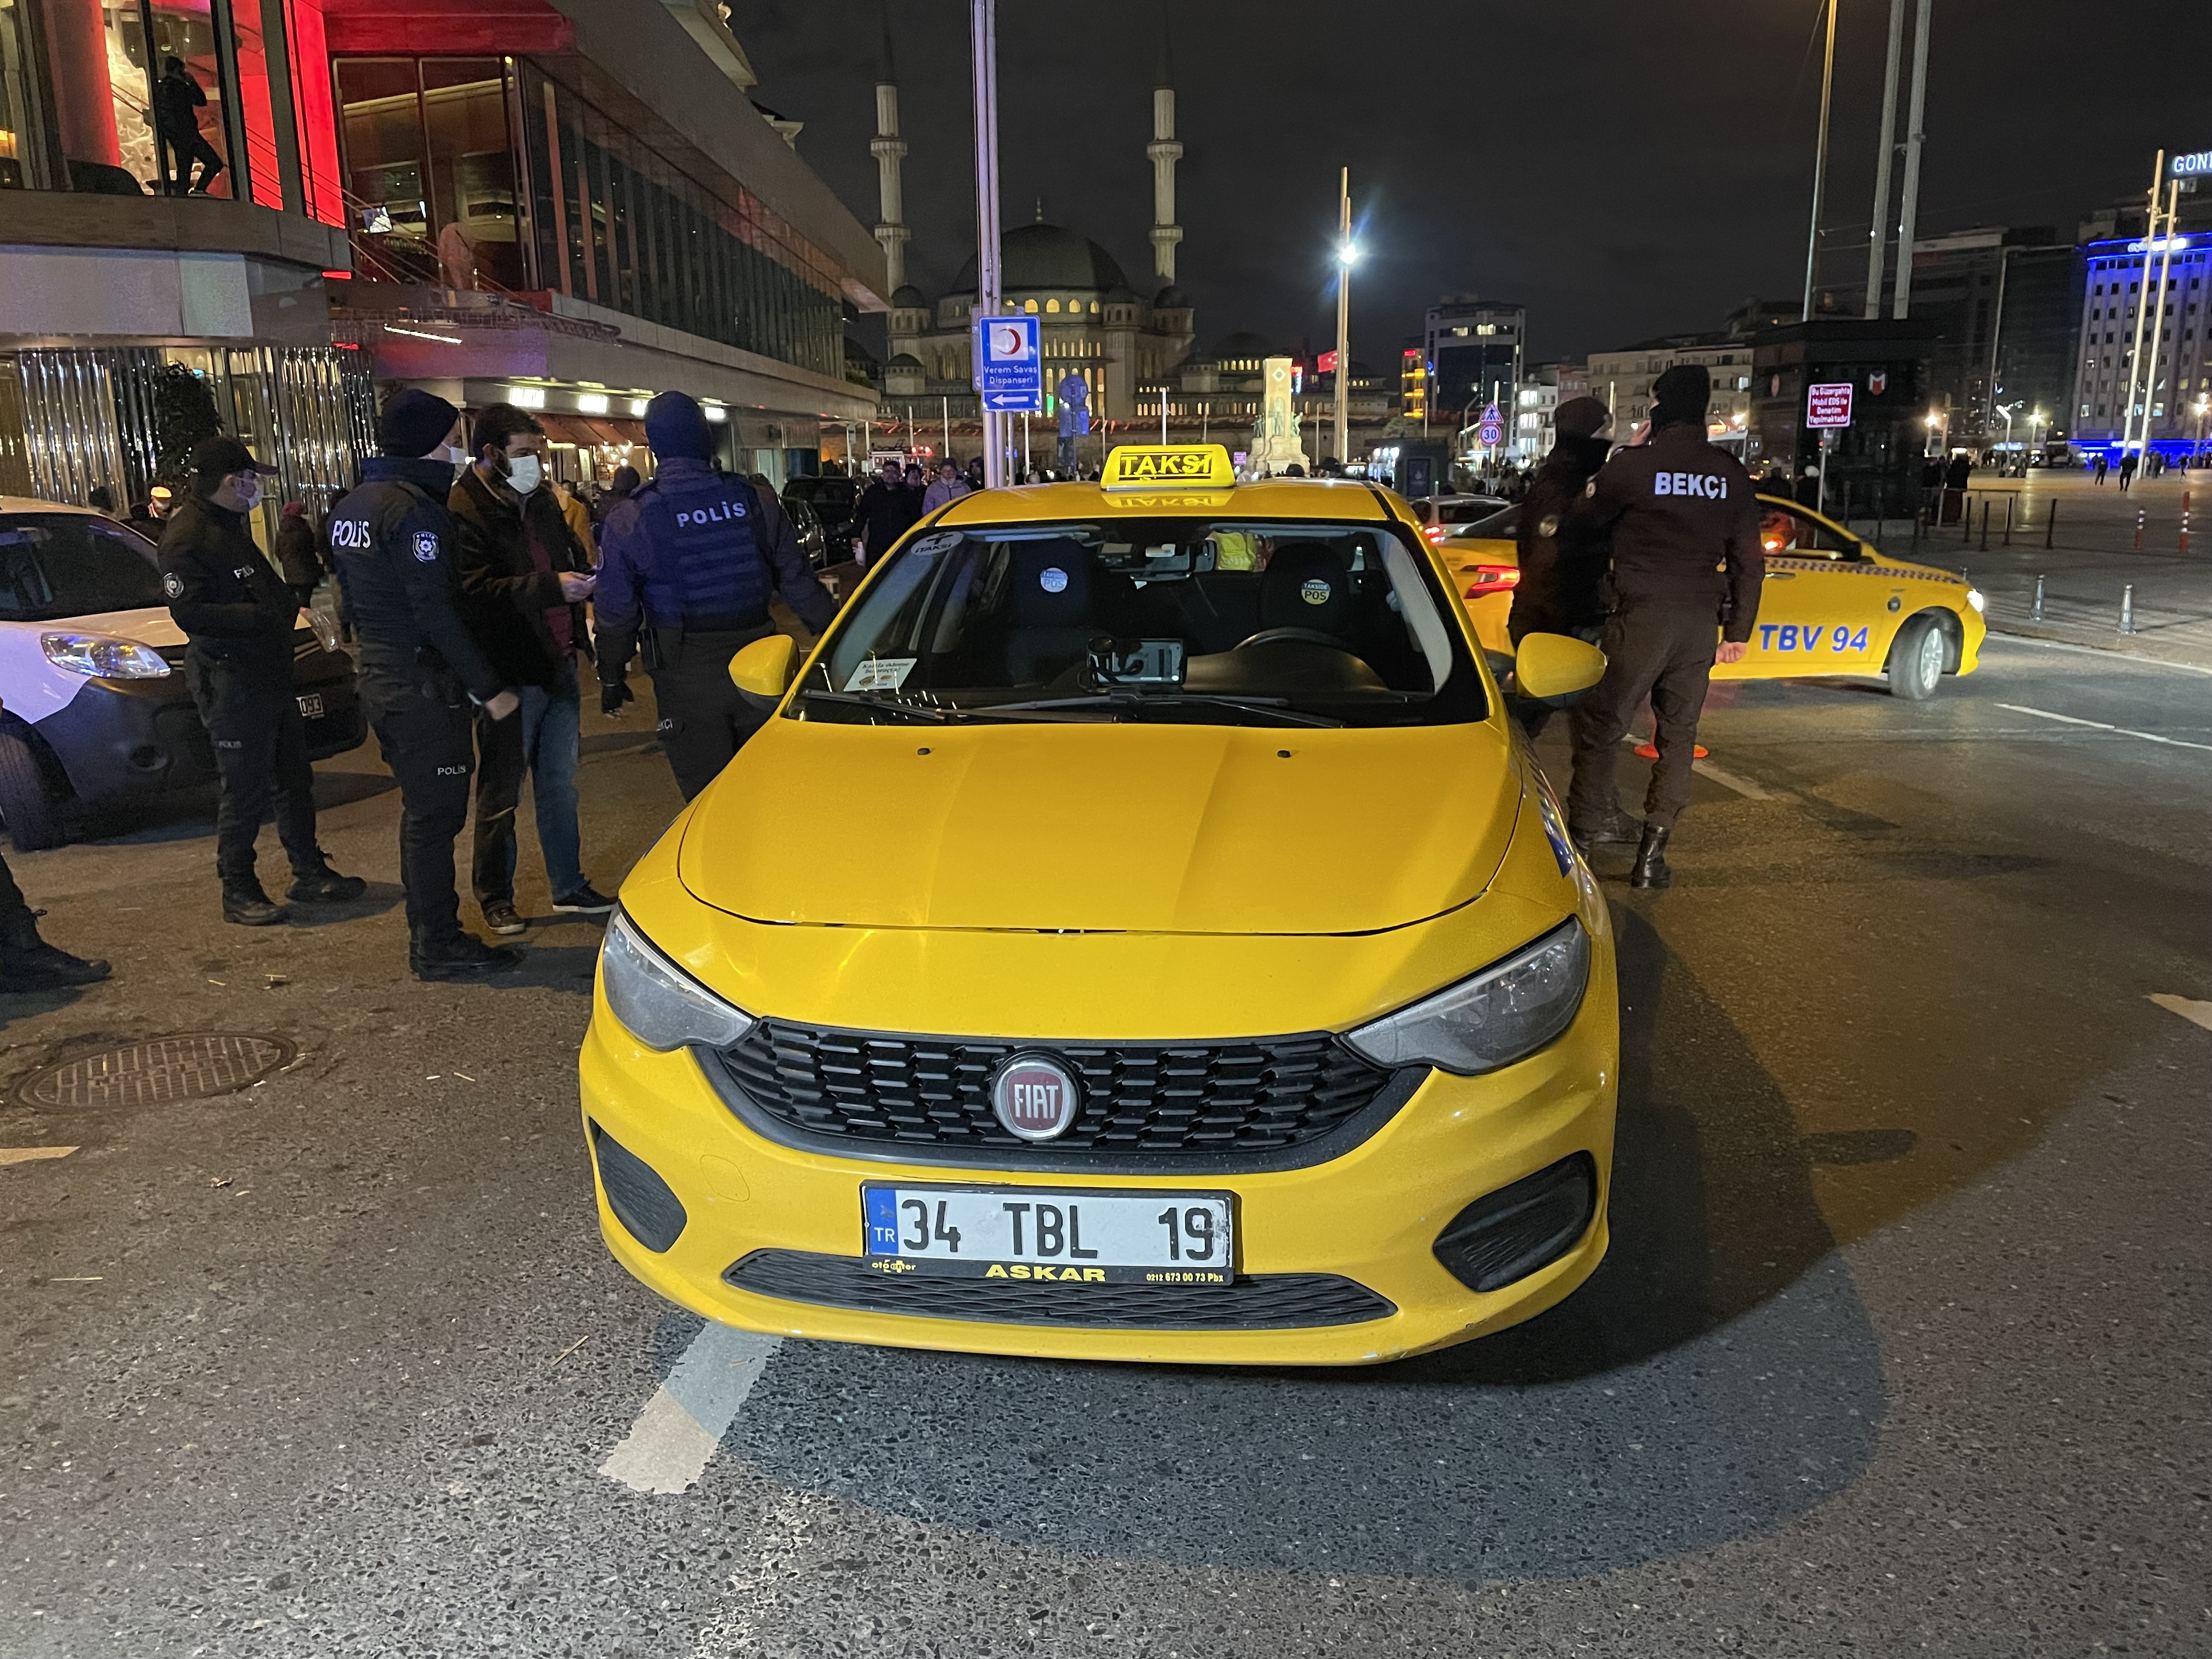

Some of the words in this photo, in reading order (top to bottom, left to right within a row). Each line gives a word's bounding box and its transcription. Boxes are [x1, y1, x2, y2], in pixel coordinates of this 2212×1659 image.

[990, 376, 1032, 385] Dispanseri
[1484, 430, 1497, 439] 30
[676, 501, 746, 527] POLİS
[332, 520, 371, 548] POLİS
[1044, 579, 1064, 588] POS
[1305, 590, 1327, 600] POS
[1759, 624, 1824, 651] TBV
[1832, 626, 1869, 652] 94
[1014, 1084, 1058, 1119] FIAT
[874, 1227, 895, 1243] TR
[902, 1199, 961, 1252] 34
[1003, 1203, 1097, 1259] TBL
[1159, 1207, 1214, 1260] 19
[985, 1264, 1105, 1282] ASKAR
[1165, 1272, 1181, 1282] 673
[1182, 1272, 1193, 1282] 00
[1195, 1273, 1205, 1282] 73
[1207, 1273, 1224, 1282] Pbx
